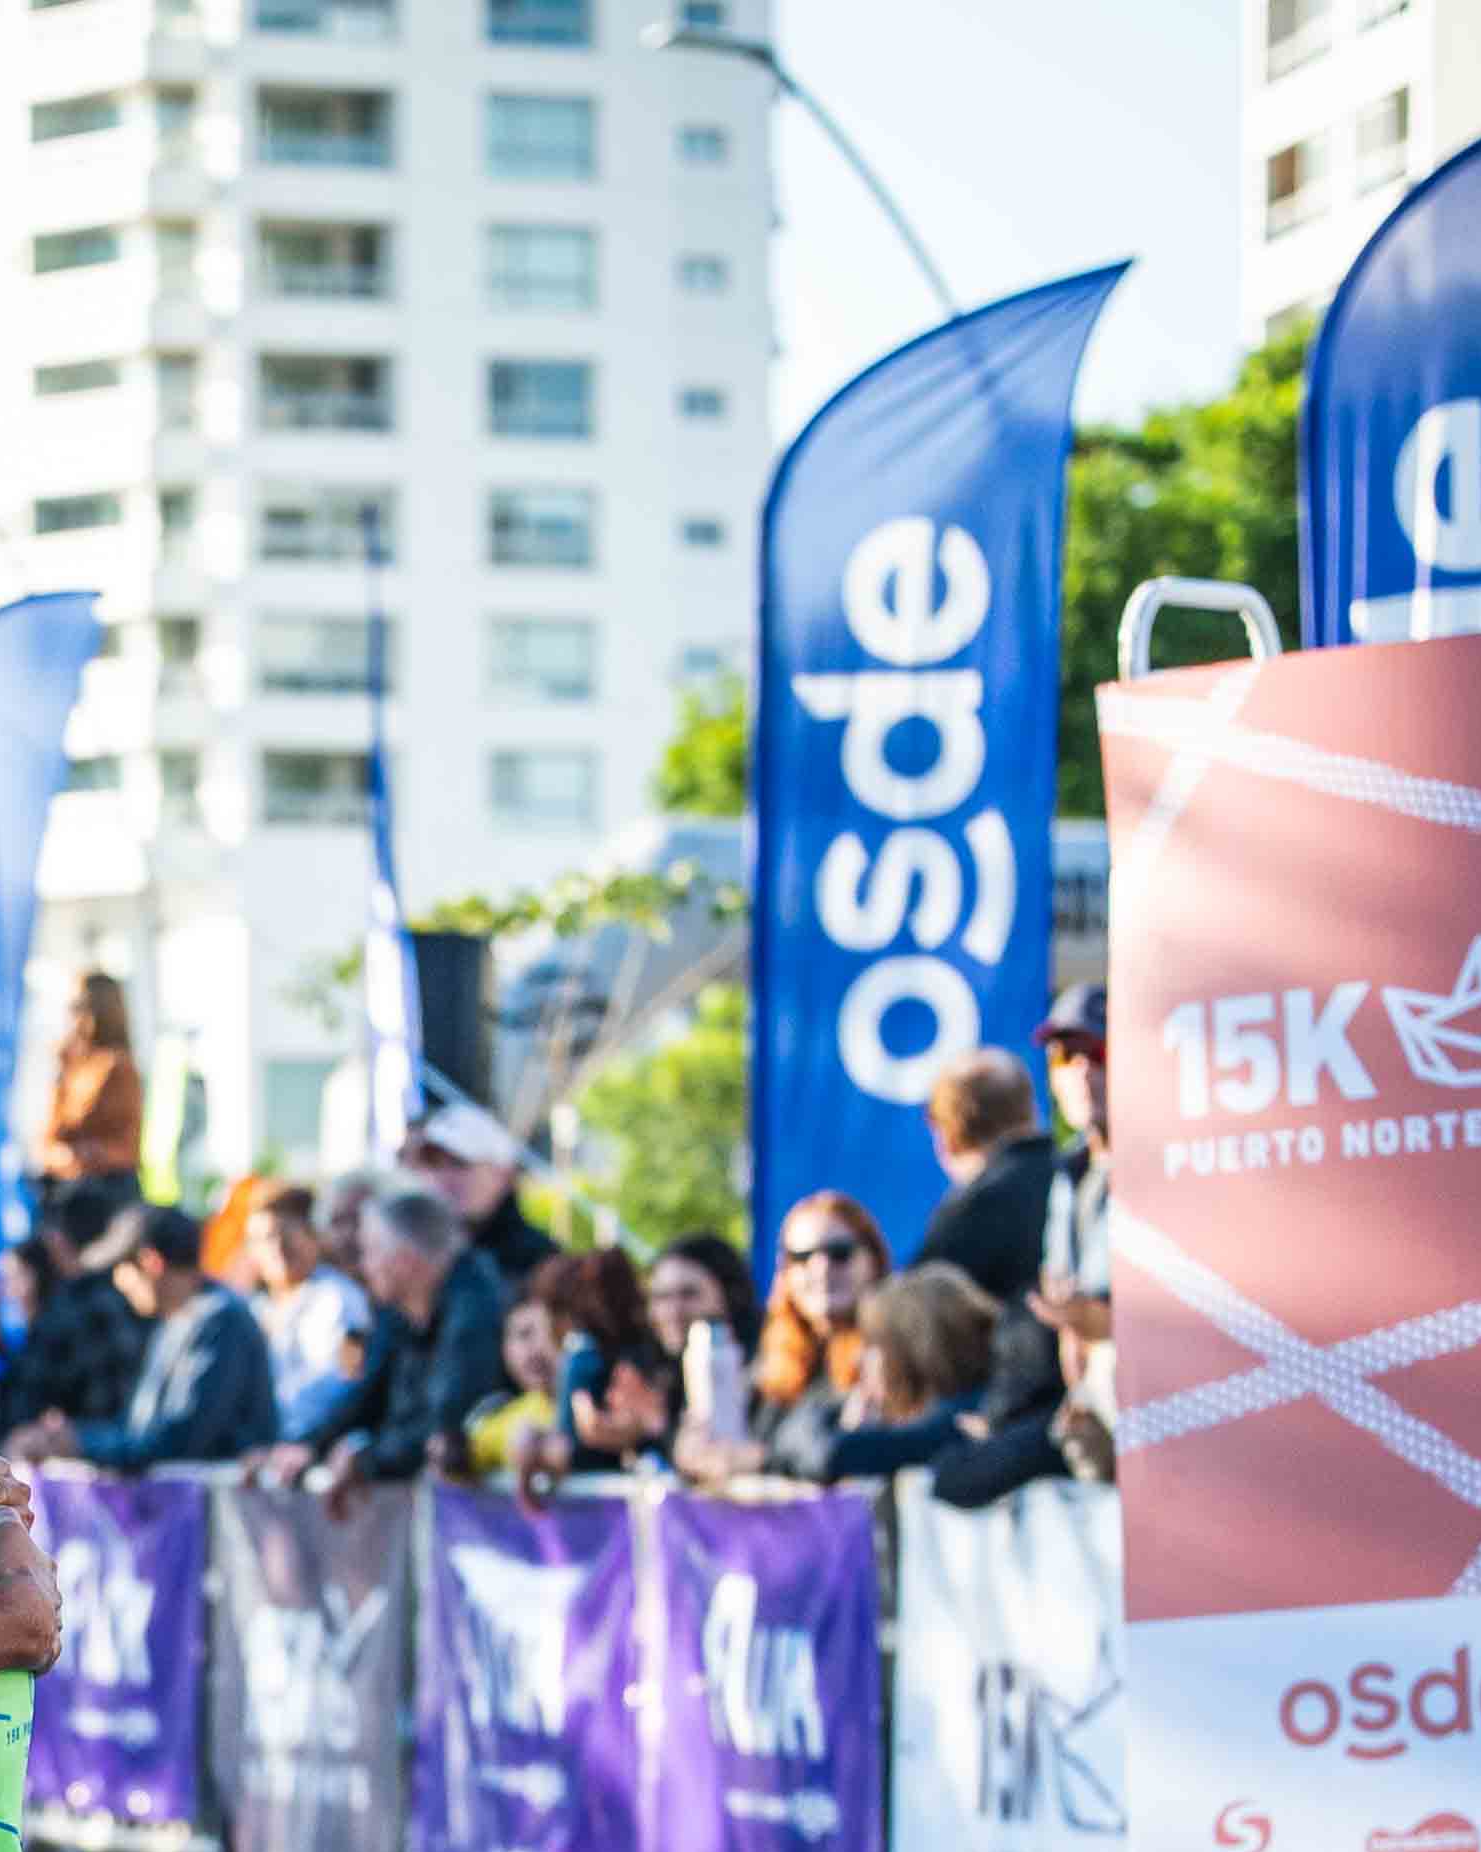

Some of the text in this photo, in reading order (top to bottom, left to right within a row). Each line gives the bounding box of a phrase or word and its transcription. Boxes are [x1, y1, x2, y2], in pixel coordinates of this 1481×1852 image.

[791, 514, 1006, 1104] osde
[1163, 980, 1378, 1120] 15K
[1163, 1125, 1326, 1180] PUERTO
